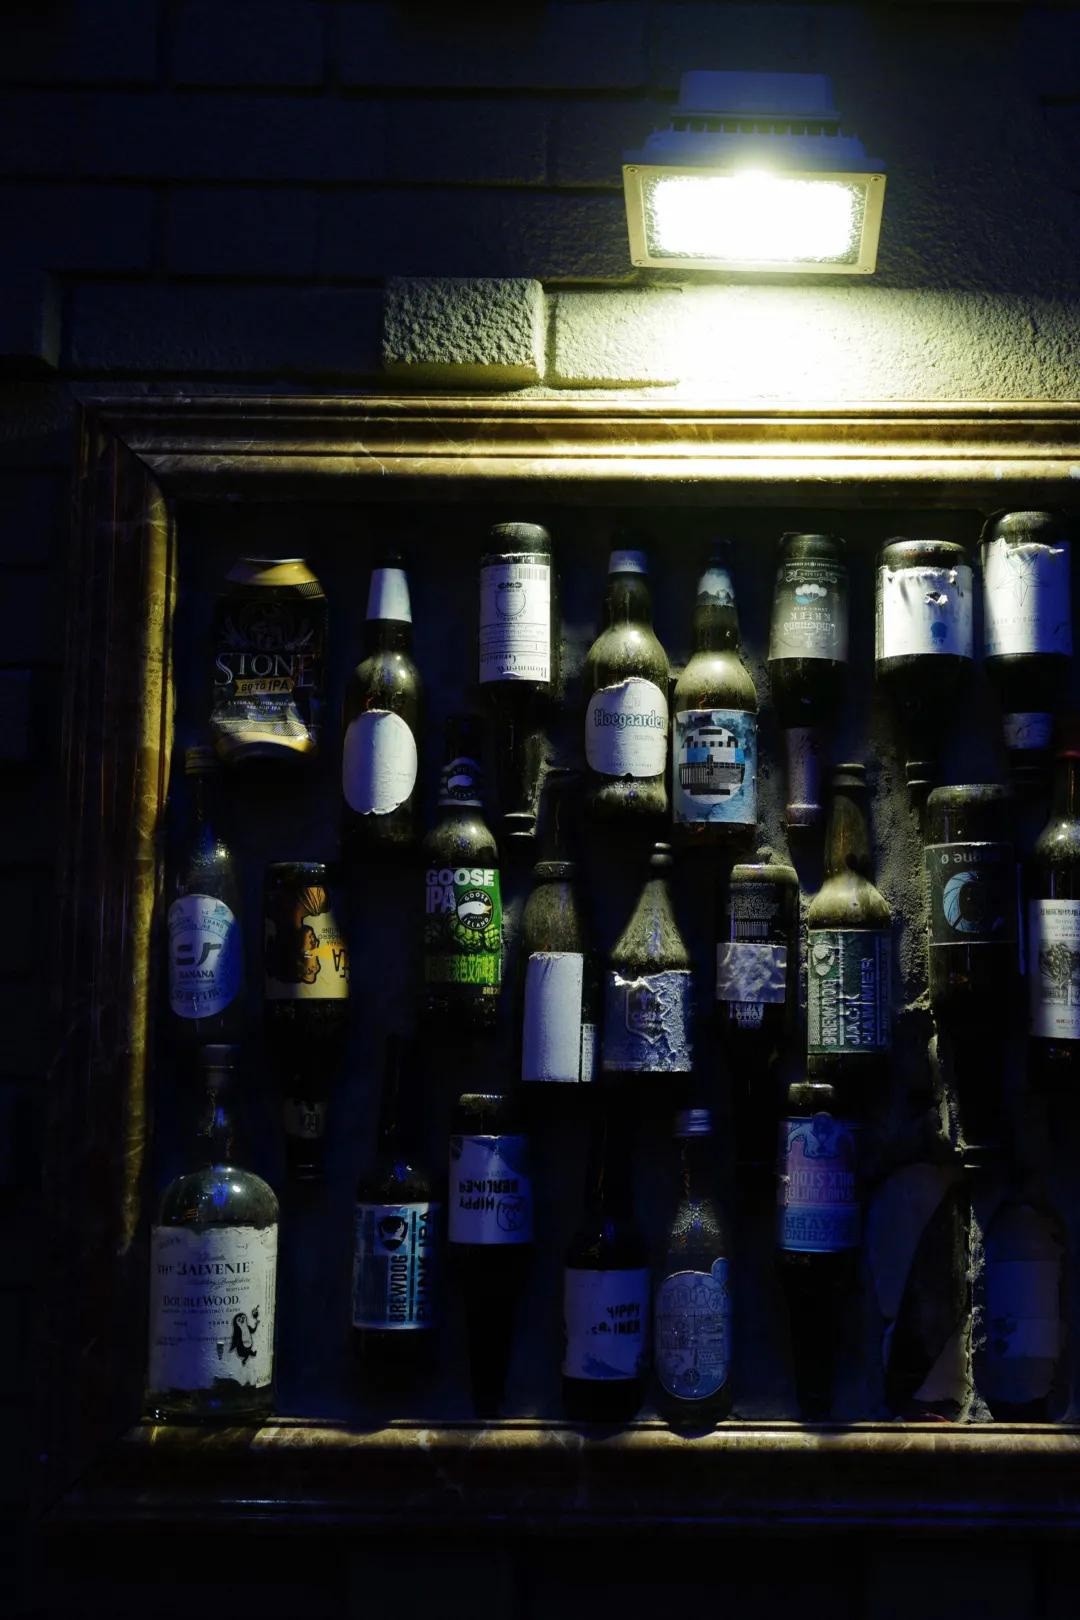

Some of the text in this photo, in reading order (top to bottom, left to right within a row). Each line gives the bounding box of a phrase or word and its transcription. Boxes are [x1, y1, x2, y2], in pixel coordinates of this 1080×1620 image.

[214, 652, 314, 687] STONE
[268, 678, 289, 692] IPA
[594, 709, 665, 729] Hoegaarden
[425, 868, 495, 886] GOOSE
[425, 885, 456, 914] IPA
[464, 892, 488, 904] GOOSE
[179, 969, 215, 978] BANANA
[861, 957, 876, 1046] HAMMER
[821, 980, 839, 1046] BREWDOG
[459, 1180, 518, 1194] BERLINER
[459, 1197, 495, 1211] HIPPY
[389, 1255, 408, 1323] BREWDOG
